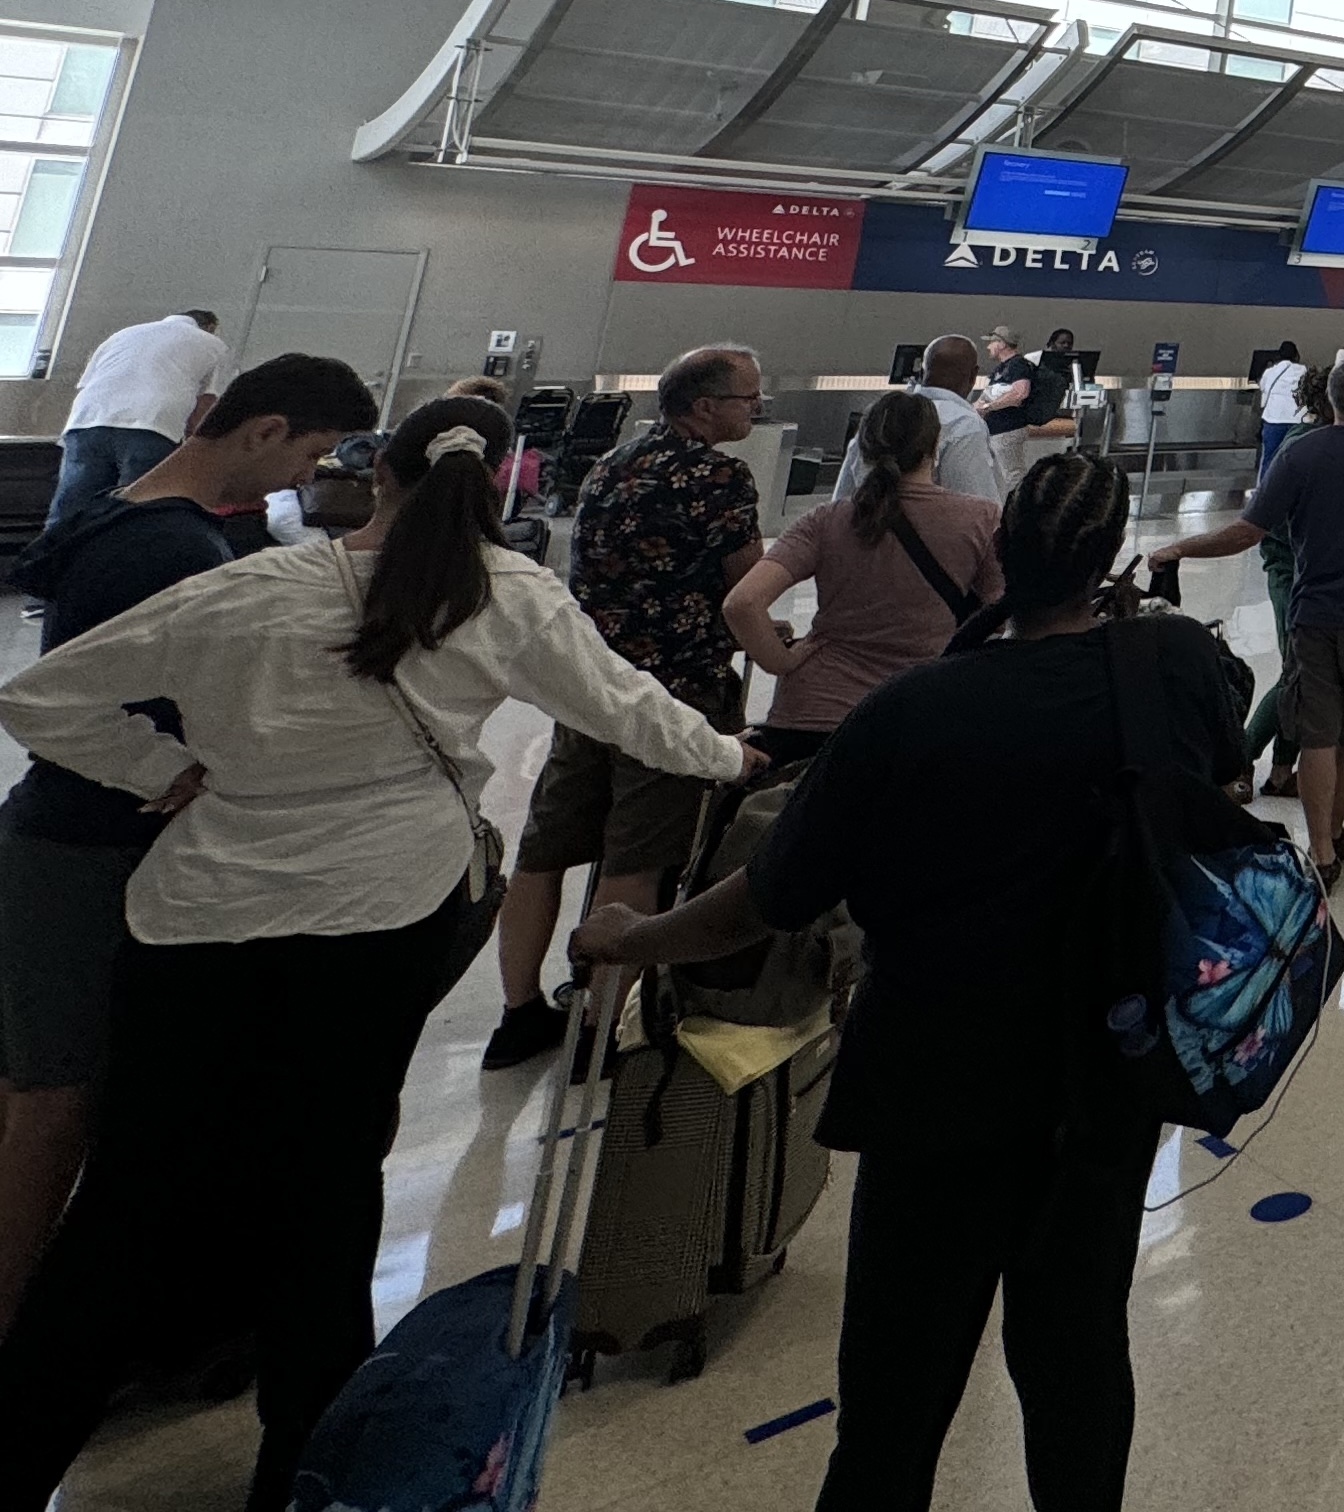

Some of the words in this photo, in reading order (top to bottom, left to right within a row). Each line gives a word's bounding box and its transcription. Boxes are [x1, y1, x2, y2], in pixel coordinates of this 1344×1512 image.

[788, 205, 840, 217] DELTA
[716, 227, 840, 246] WHEELCHAIR
[963, 231, 969, 242] 1
[1081, 239, 1092, 250] 2
[712, 243, 828, 261] ASSISTANCE
[992, 245, 1120, 273] DELTA
[1294, 254, 1303, 264] 3
